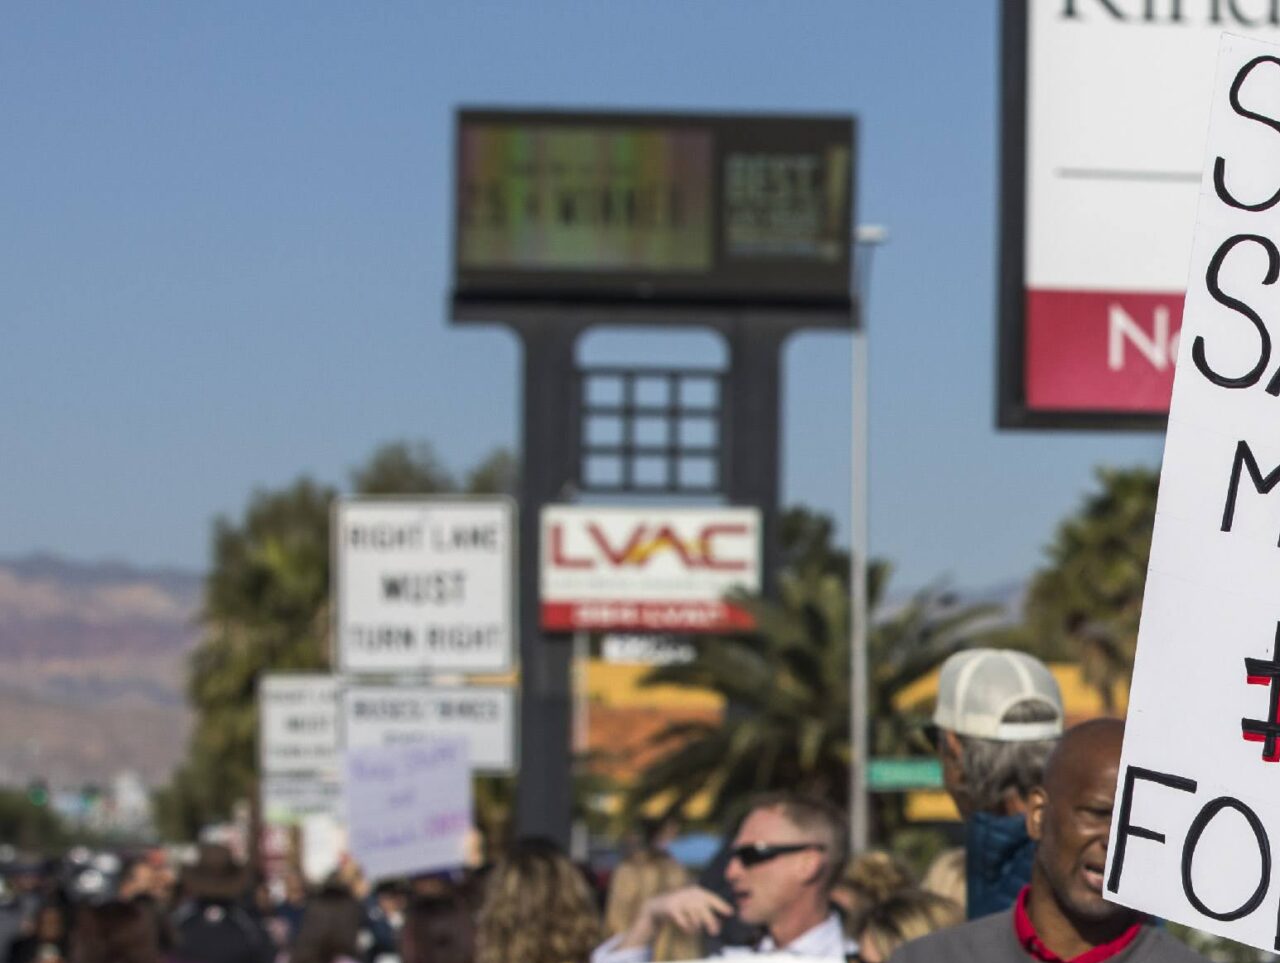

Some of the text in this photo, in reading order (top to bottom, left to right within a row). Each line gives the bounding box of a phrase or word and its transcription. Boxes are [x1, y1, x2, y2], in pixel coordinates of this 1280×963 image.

[351, 523, 499, 551] RIGHT LANE
[551, 521, 749, 569] LVAC
[380, 571, 466, 604] MUST
[351, 622, 500, 650] TURN RIGHT
